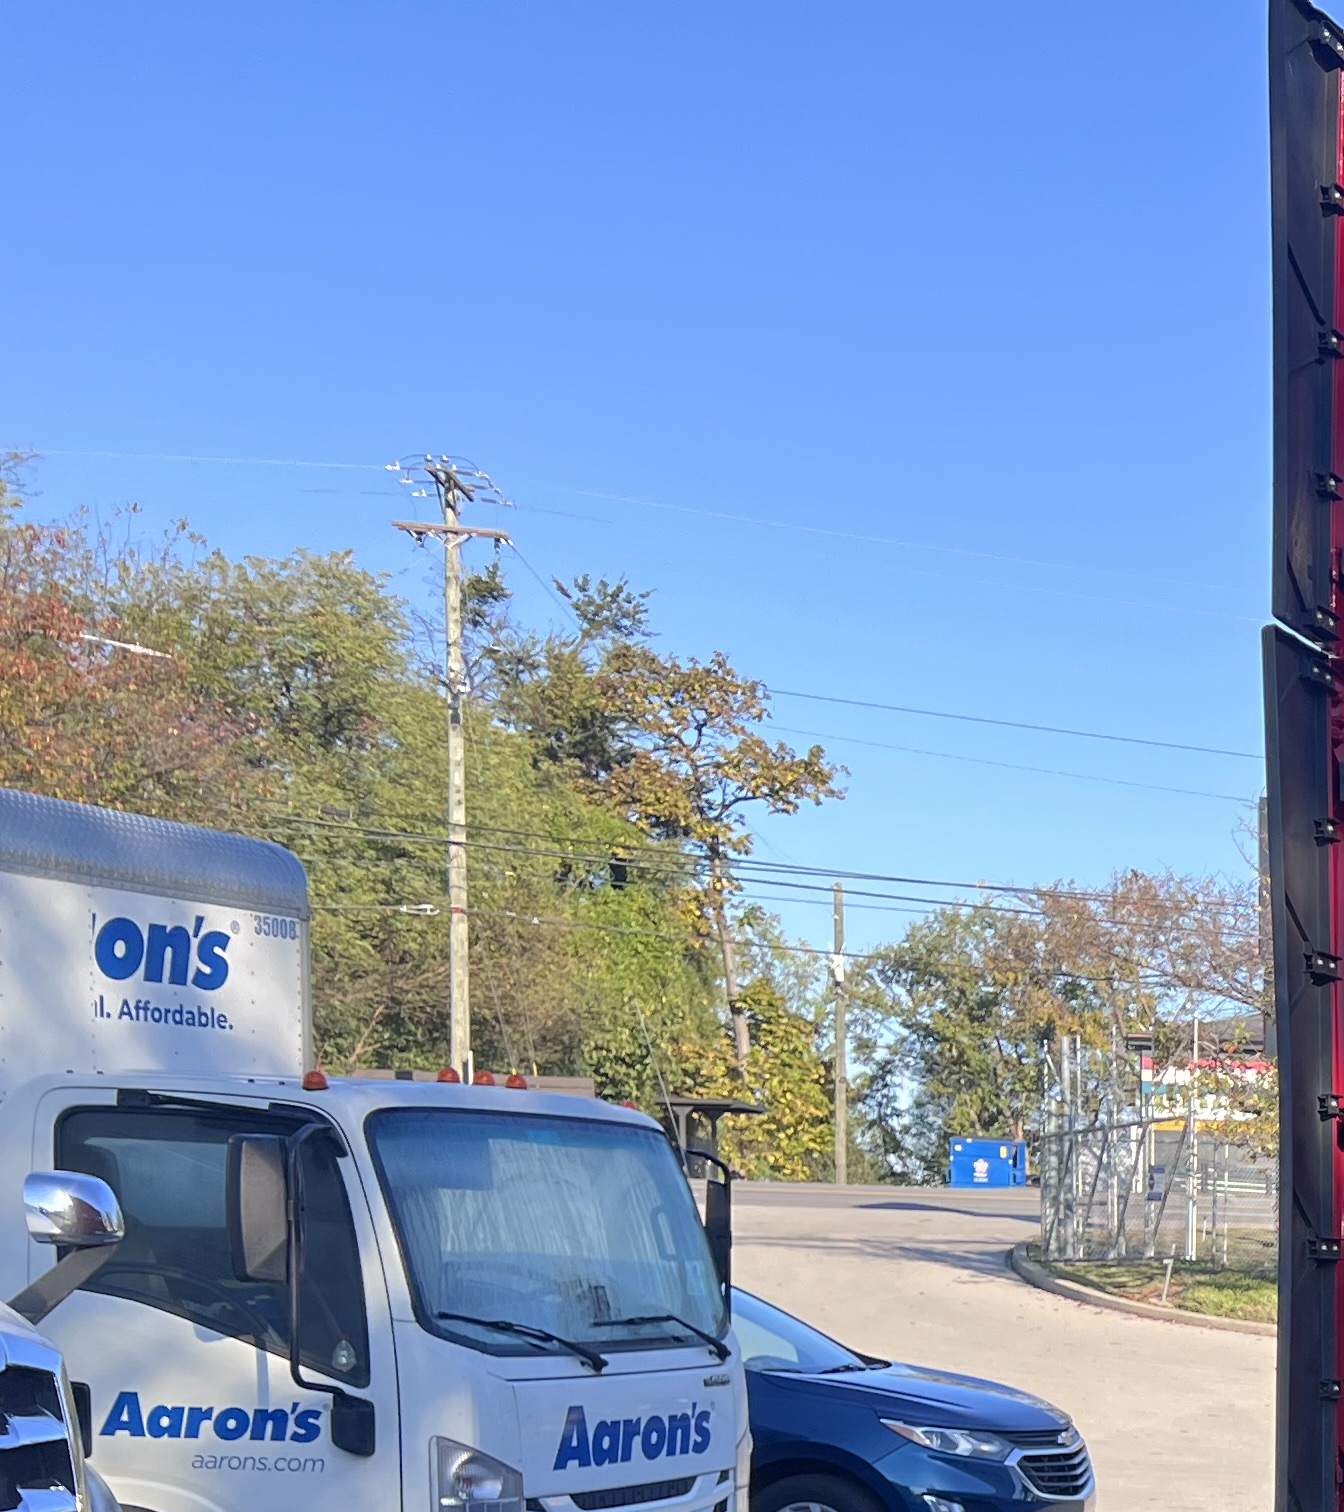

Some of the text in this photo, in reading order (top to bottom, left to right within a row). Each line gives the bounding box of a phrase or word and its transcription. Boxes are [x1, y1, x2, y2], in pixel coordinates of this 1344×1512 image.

[254, 915, 297, 940] 35008
[92, 913, 231, 991] on's
[118, 998, 234, 1030] Affordable.
[99, 1391, 323, 1443] Aaron's
[553, 1401, 711, 1471] Aaron's
[191, 1454, 325, 1473] aarons.com
